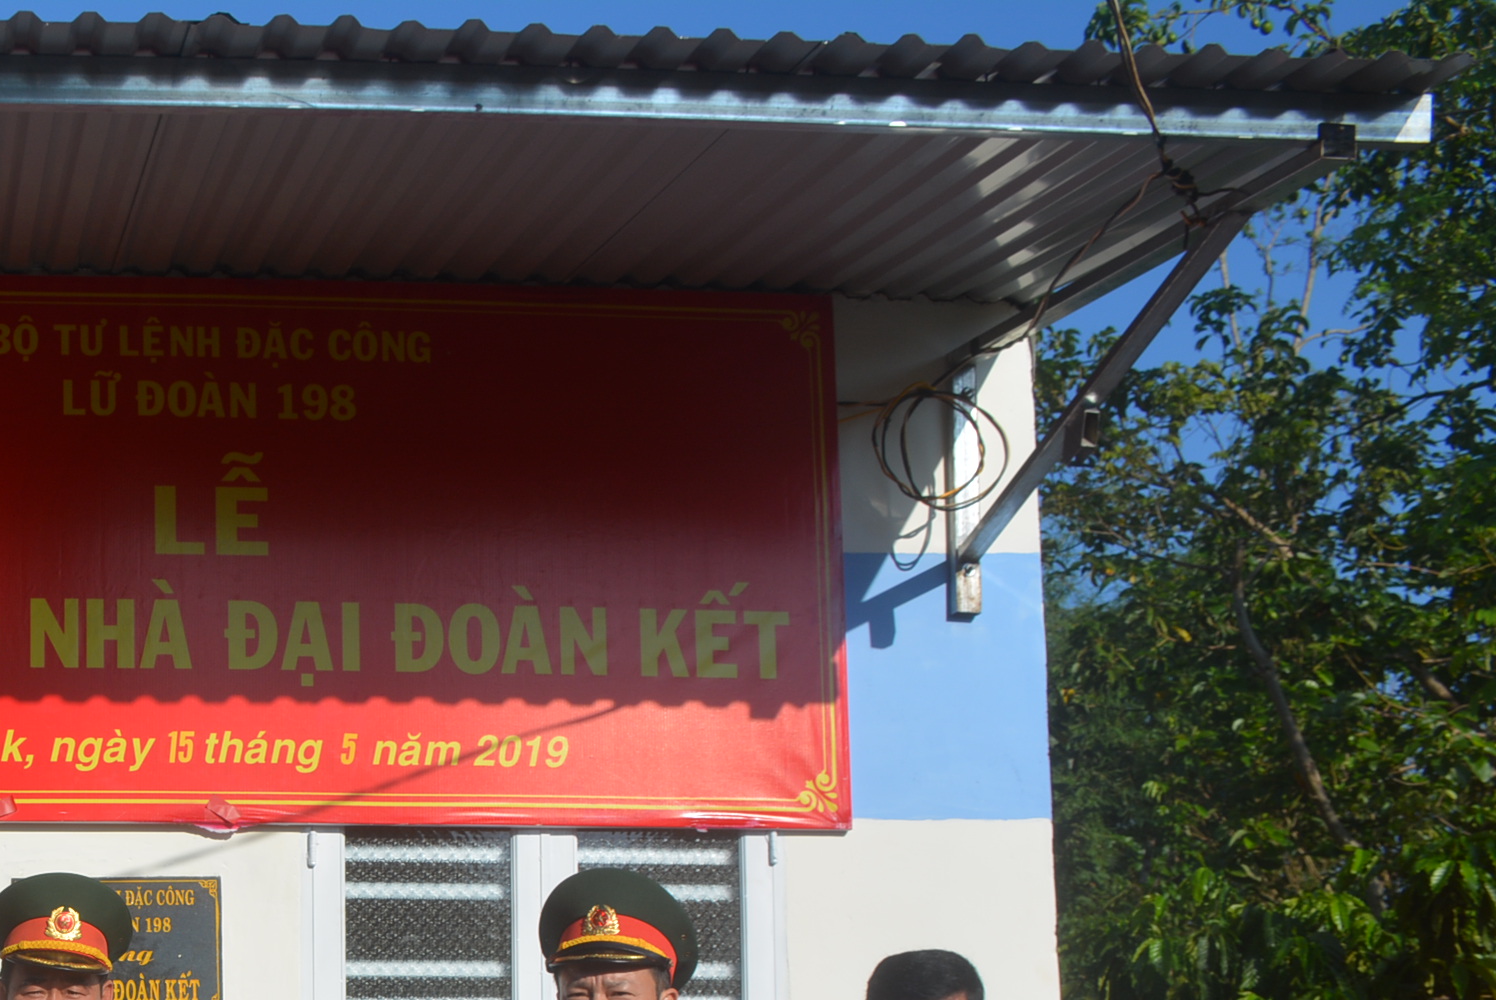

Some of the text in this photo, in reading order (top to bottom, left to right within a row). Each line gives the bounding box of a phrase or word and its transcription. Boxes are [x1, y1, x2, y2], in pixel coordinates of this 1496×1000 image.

[53, 318, 108, 357] TƯ
[119, 316, 220, 363] LỆNH
[236, 320, 314, 368] ĐẶC
[328, 321, 431, 363] CÔNG
[62, 370, 357, 421] LỮ ĐOÀN 198
[154, 452, 269, 556] LỄ
[29, 579, 193, 669] NHÀ
[224, 600, 360, 687] ĐẠI
[391, 585, 607, 676] ĐOÀN
[639, 581, 790, 680] KẾT
[50, 729, 156, 772] ngày
[168, 730, 196, 764] 15
[204, 730, 323, 774] tháng
[340, 733, 358, 765] 5
[372, 732, 461, 766] năm
[473, 734, 569, 768] 2019
[125, 885, 195, 909] ĐẶC CÔNG
[145, 916, 172, 933] 198
